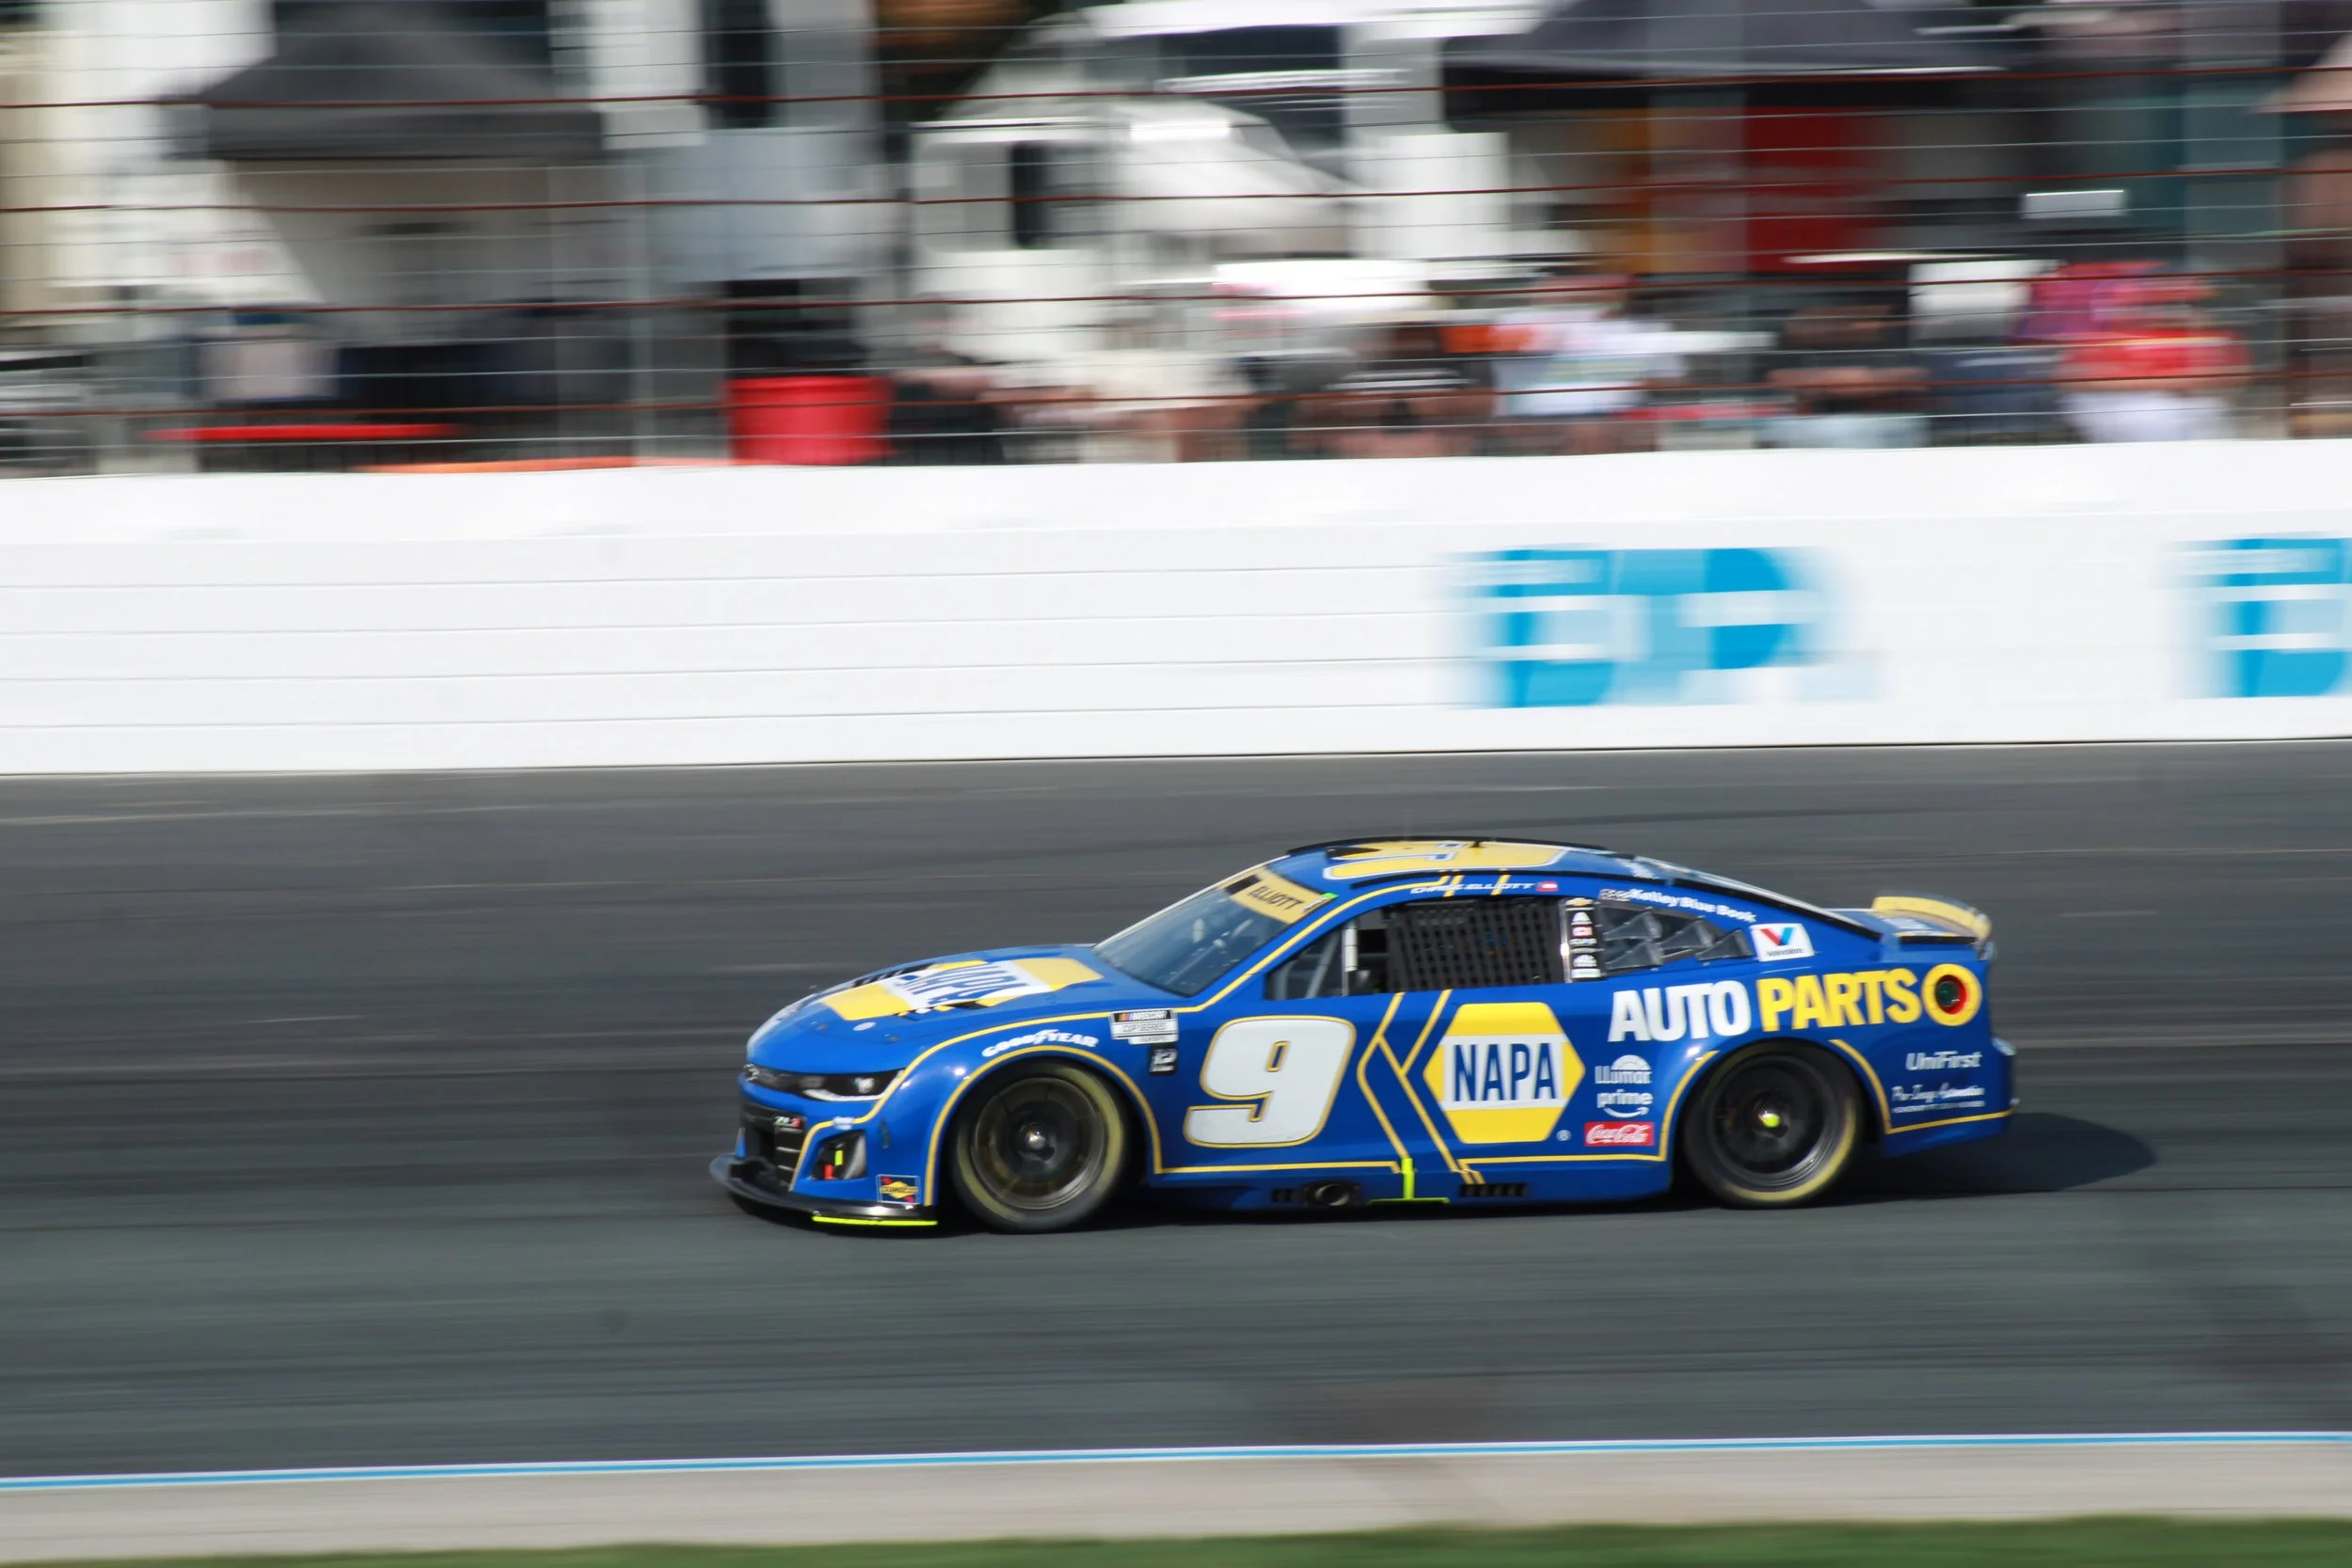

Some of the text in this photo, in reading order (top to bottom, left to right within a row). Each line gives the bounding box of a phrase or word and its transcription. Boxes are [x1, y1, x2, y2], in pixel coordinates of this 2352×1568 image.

[1248, 885, 1304, 911] ELLIOTT
[1628, 888, 1757, 923] Kelley Blue Book
[1608, 968, 1922, 1042] AUTO PARTS
[981, 1029, 1099, 1057] GOODYEAR
[1454, 1042, 1558, 1103] NAPA
[1905, 1051, 1982, 1070] UniFirst
[1184, 1015, 1357, 1148] 9
[1597, 1088, 1654, 1108] prime
